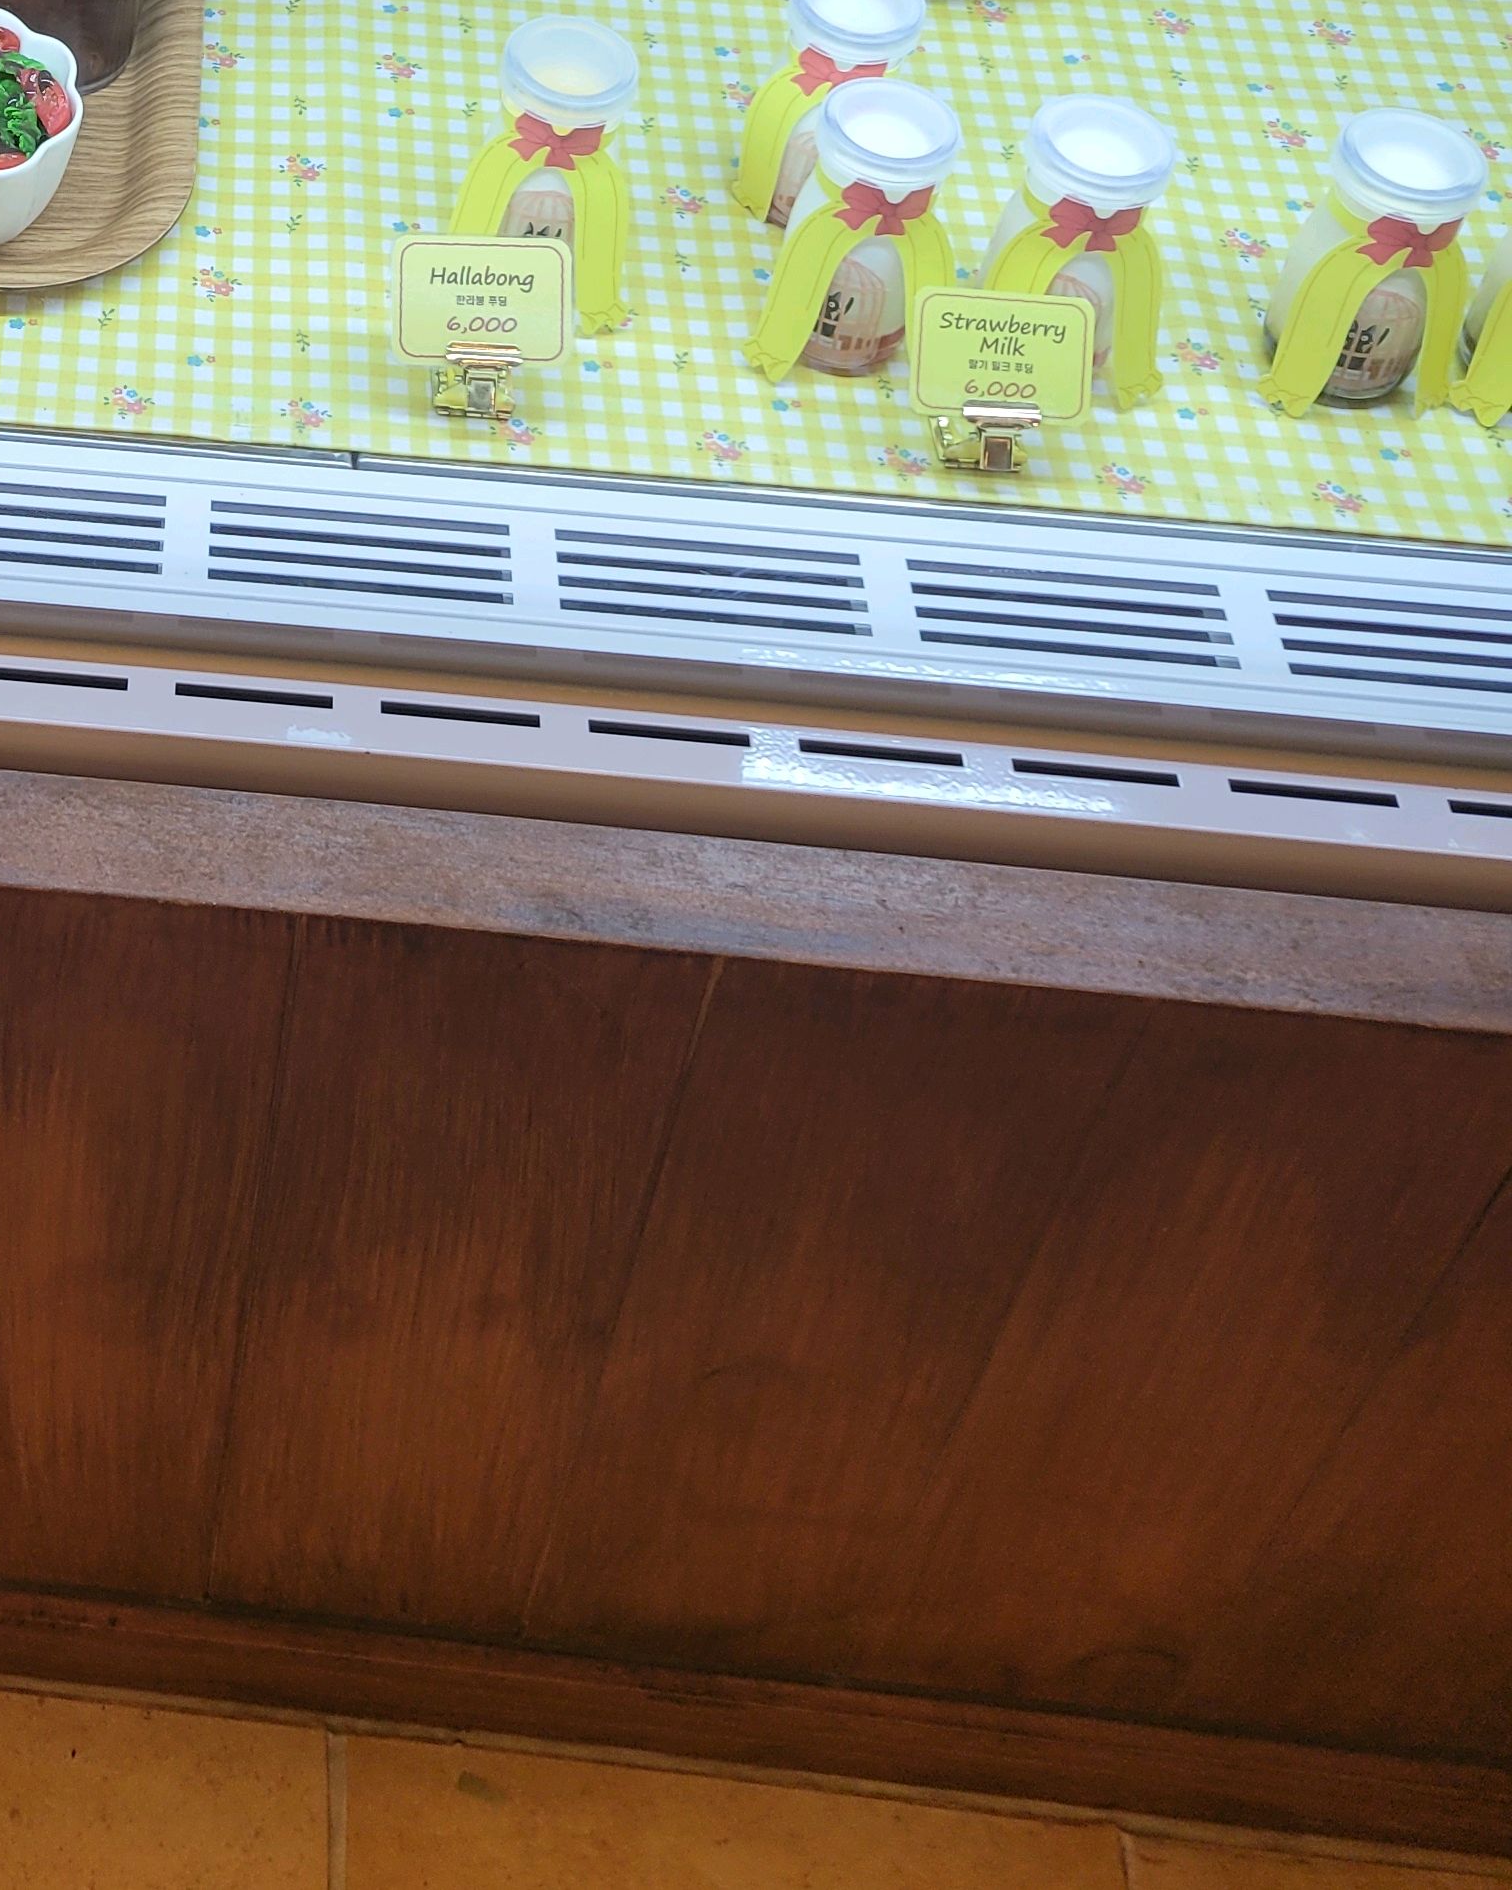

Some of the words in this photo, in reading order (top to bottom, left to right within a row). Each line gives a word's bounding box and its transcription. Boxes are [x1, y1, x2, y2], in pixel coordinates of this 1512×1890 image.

[429, 265, 535, 293] Hallabong
[456, 295, 485, 306] 한라봉
[488, 295, 507, 307] 푸딩
[446, 316, 518, 334] 6,000
[939, 312, 1066, 344] Strawberry
[979, 336, 1026, 357] Milk
[968, 359, 988, 370] 딸기
[991, 360, 1011, 372] 밀크
[1014, 362, 1033, 374] 푸딩
[964, 379, 1037, 399] 6,000
